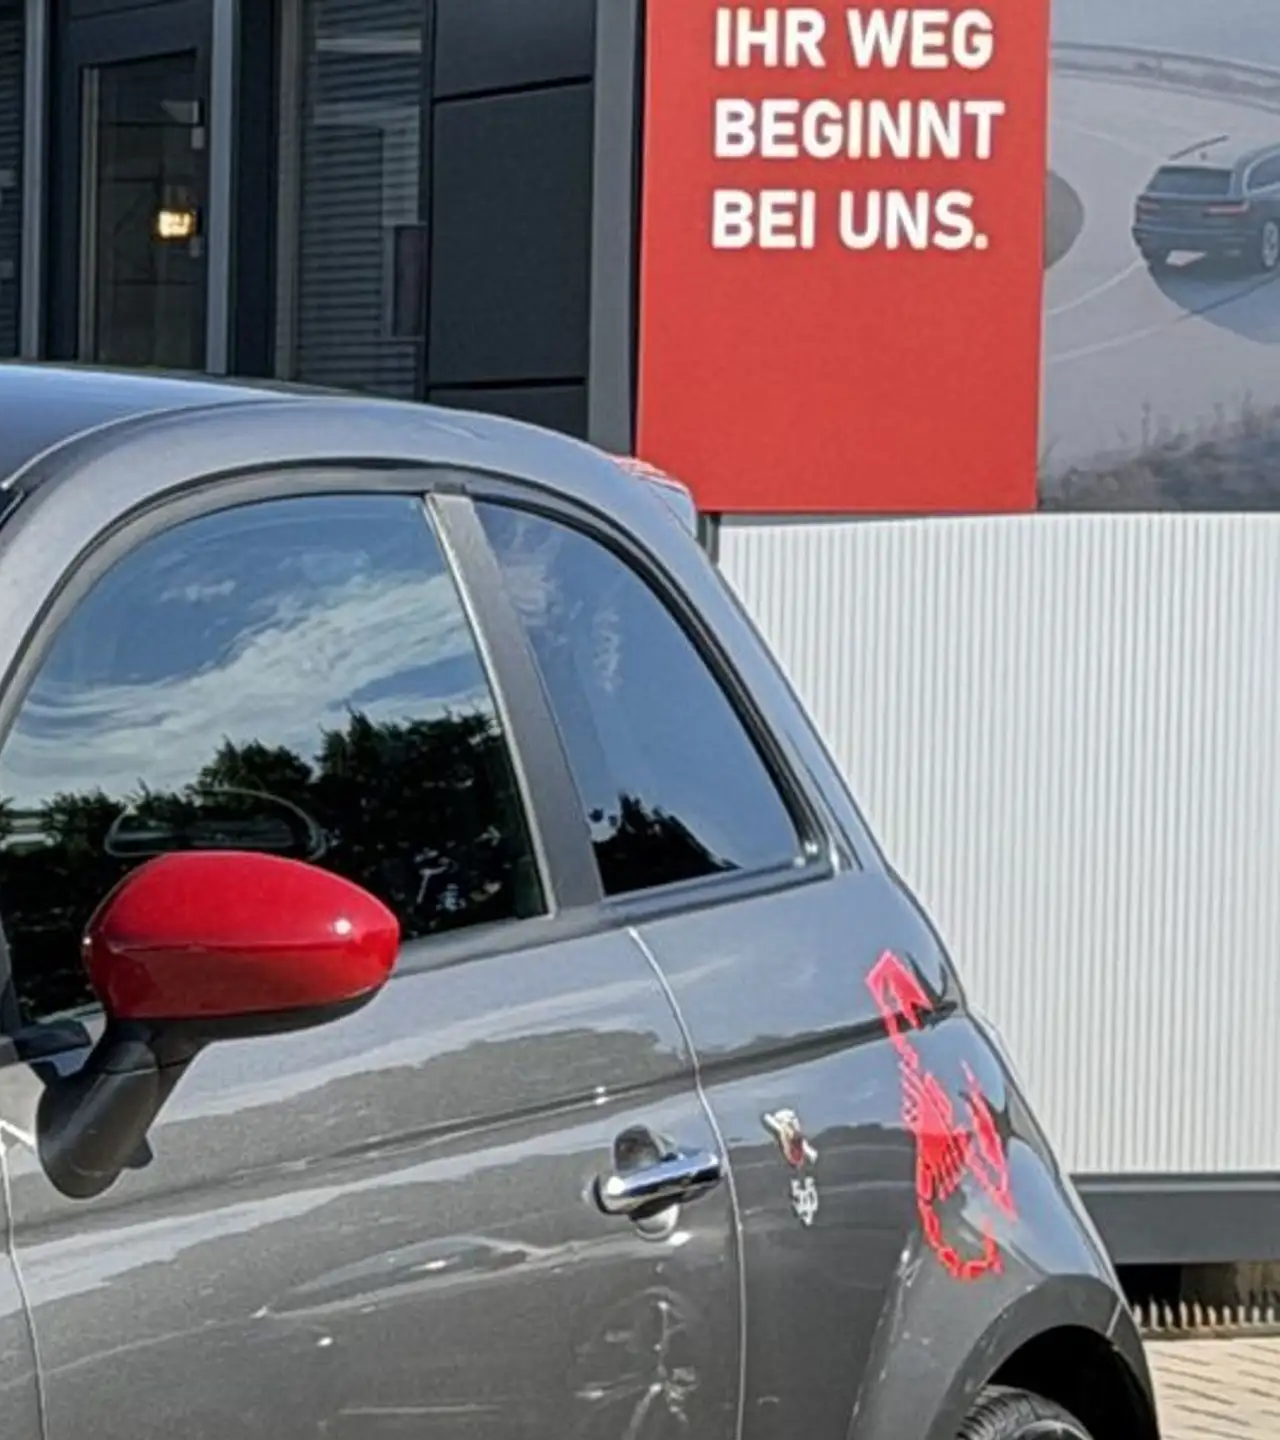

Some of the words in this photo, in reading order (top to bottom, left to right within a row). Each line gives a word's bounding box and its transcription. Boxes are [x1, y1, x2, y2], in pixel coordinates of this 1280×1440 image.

[714, 8, 826, 68] IHR
[847, 9, 995, 68] WEG
[714, 98, 1005, 159] BEGINNT
[712, 189, 816, 249] BEI
[840, 189, 988, 249] UNS.
